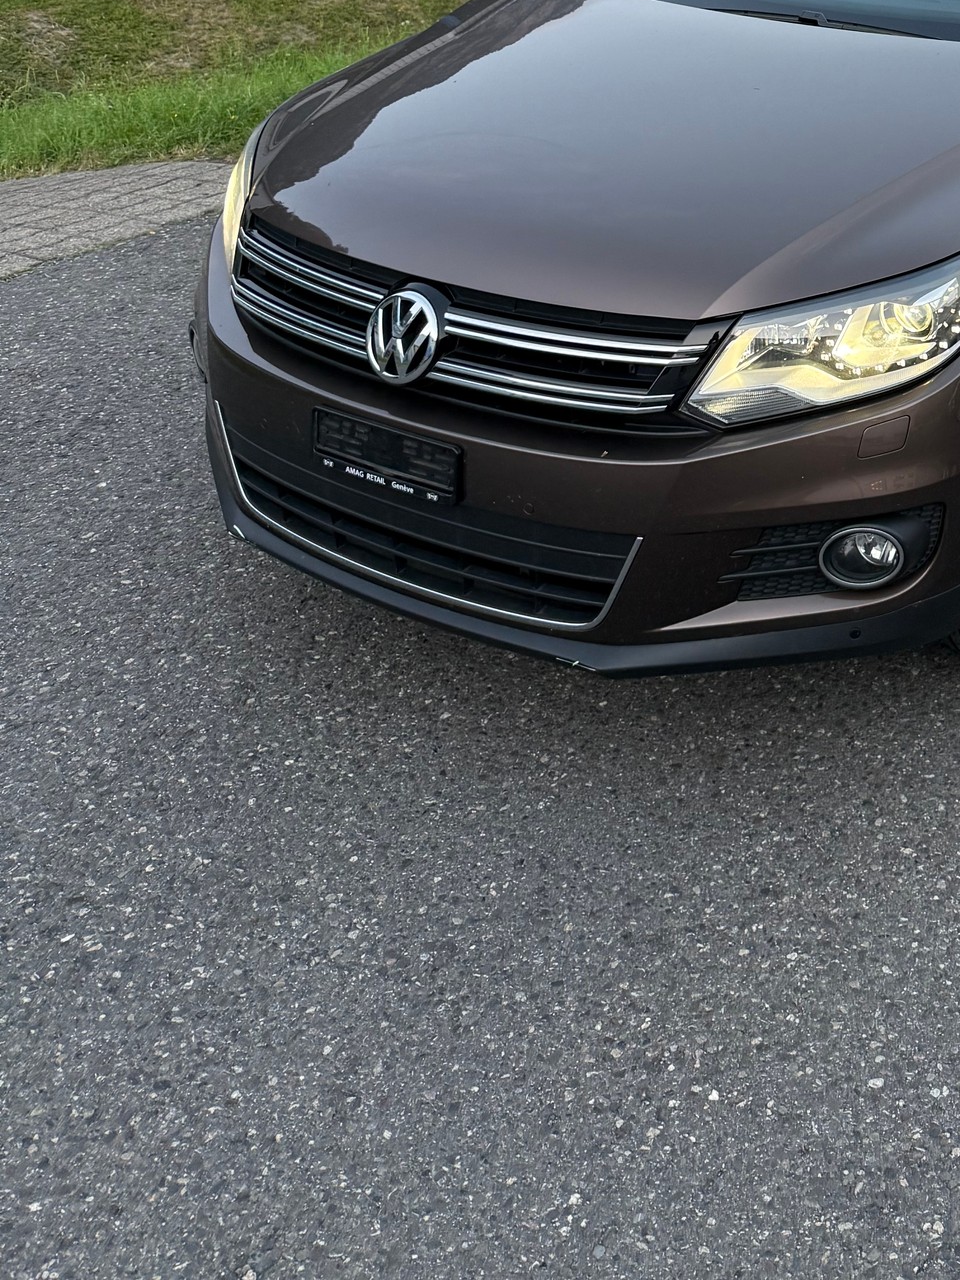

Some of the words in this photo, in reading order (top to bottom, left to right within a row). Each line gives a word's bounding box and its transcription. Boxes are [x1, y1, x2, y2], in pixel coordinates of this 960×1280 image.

[345, 466, 365, 478] AMAG
[366, 473, 386, 486] RETAIL
[391, 481, 414, 495] Genève
